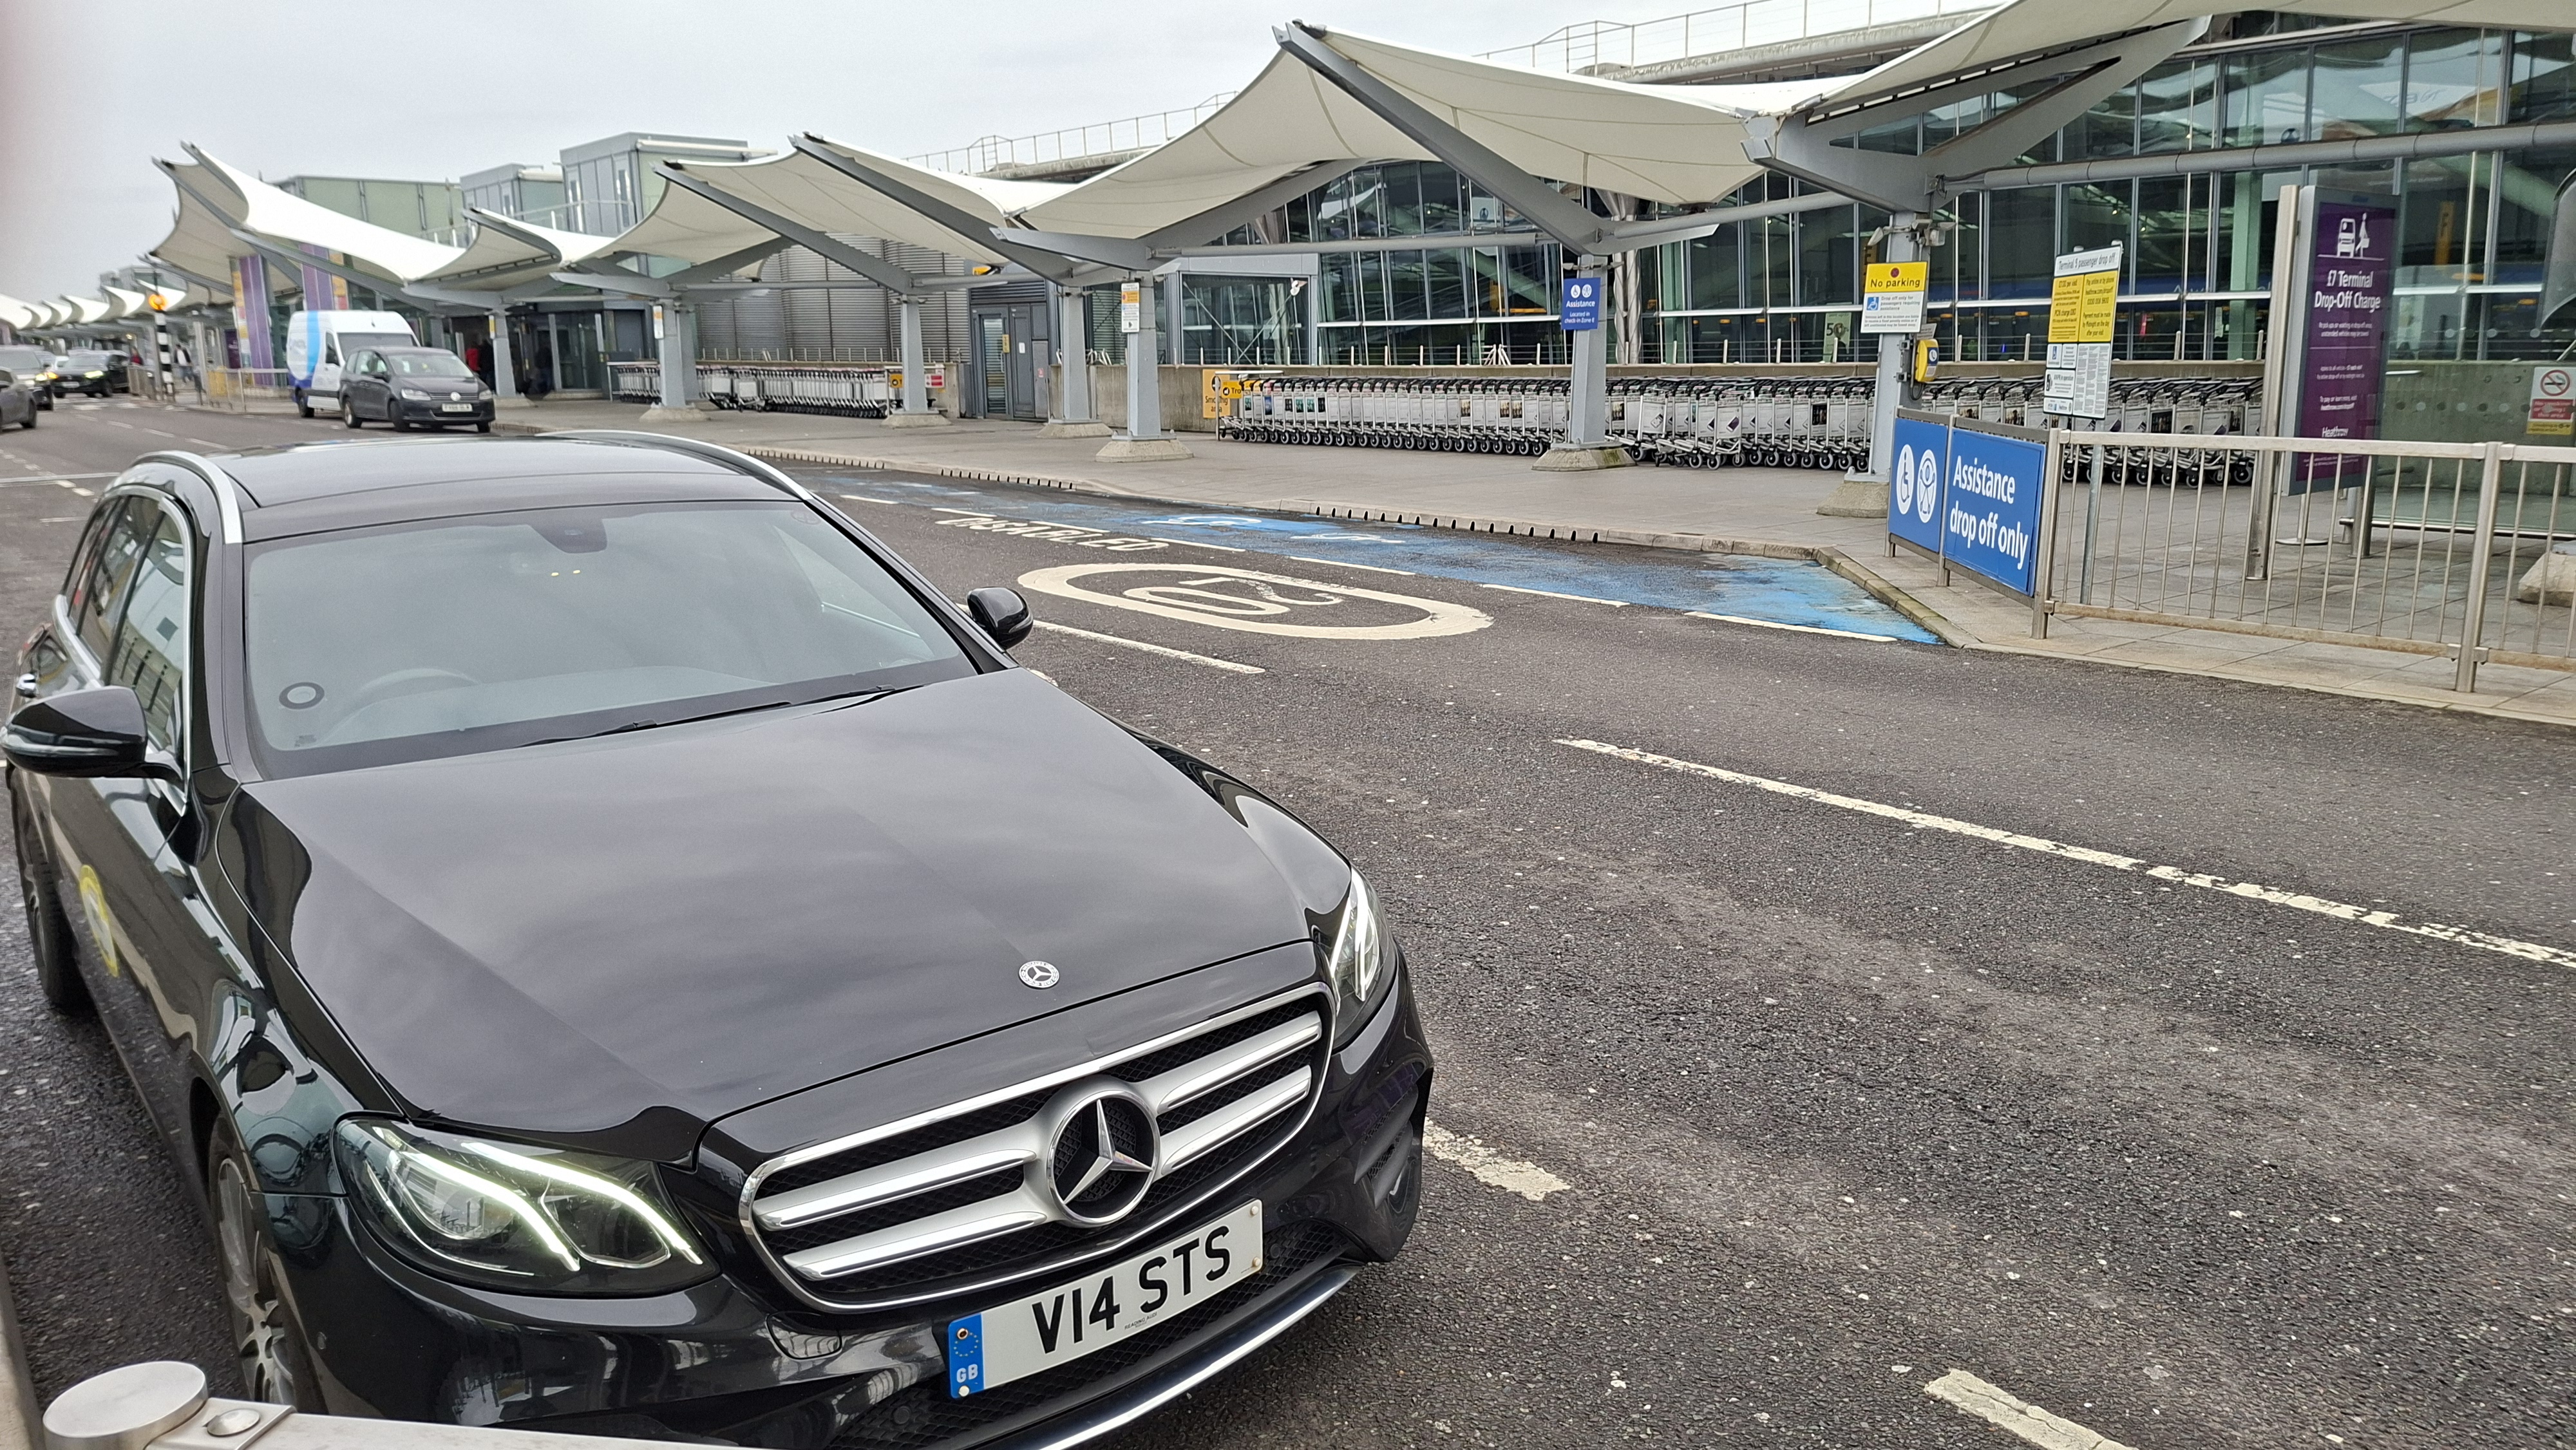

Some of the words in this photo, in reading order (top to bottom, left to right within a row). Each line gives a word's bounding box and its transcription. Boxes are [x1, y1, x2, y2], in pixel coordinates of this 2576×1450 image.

[2059, 258, 2075, 270] Terminal
[2078, 257, 2098, 269] passenger
[2099, 254, 2108, 265] drop
[1870, 279, 1883, 288] No
[1886, 278, 1920, 288] parking
[2327, 269, 2336, 287] £7
[2338, 270, 2373, 288] Terminal
[1566, 299, 1595, 308] Assistance
[2315, 290, 2353, 312] Drop-Off
[2354, 292, 2381, 314] Charge
[1205, 396, 1228, 406] Smoing
[1953, 455, 2015, 504] Assistance
[934, 517, 1170, 551] DISABLED
[1950, 500, 1976, 549] drop
[1978, 512, 1998, 549] off
[1998, 522, 2029, 570] only
[1032, 1276, 1121, 1355] V14
[1139, 1225, 1231, 1313] STS
[1124, 1317, 1146, 1330] READING
[1146, 1312, 1157, 1321] AUDI
[956, 1364, 978, 1384] GB
